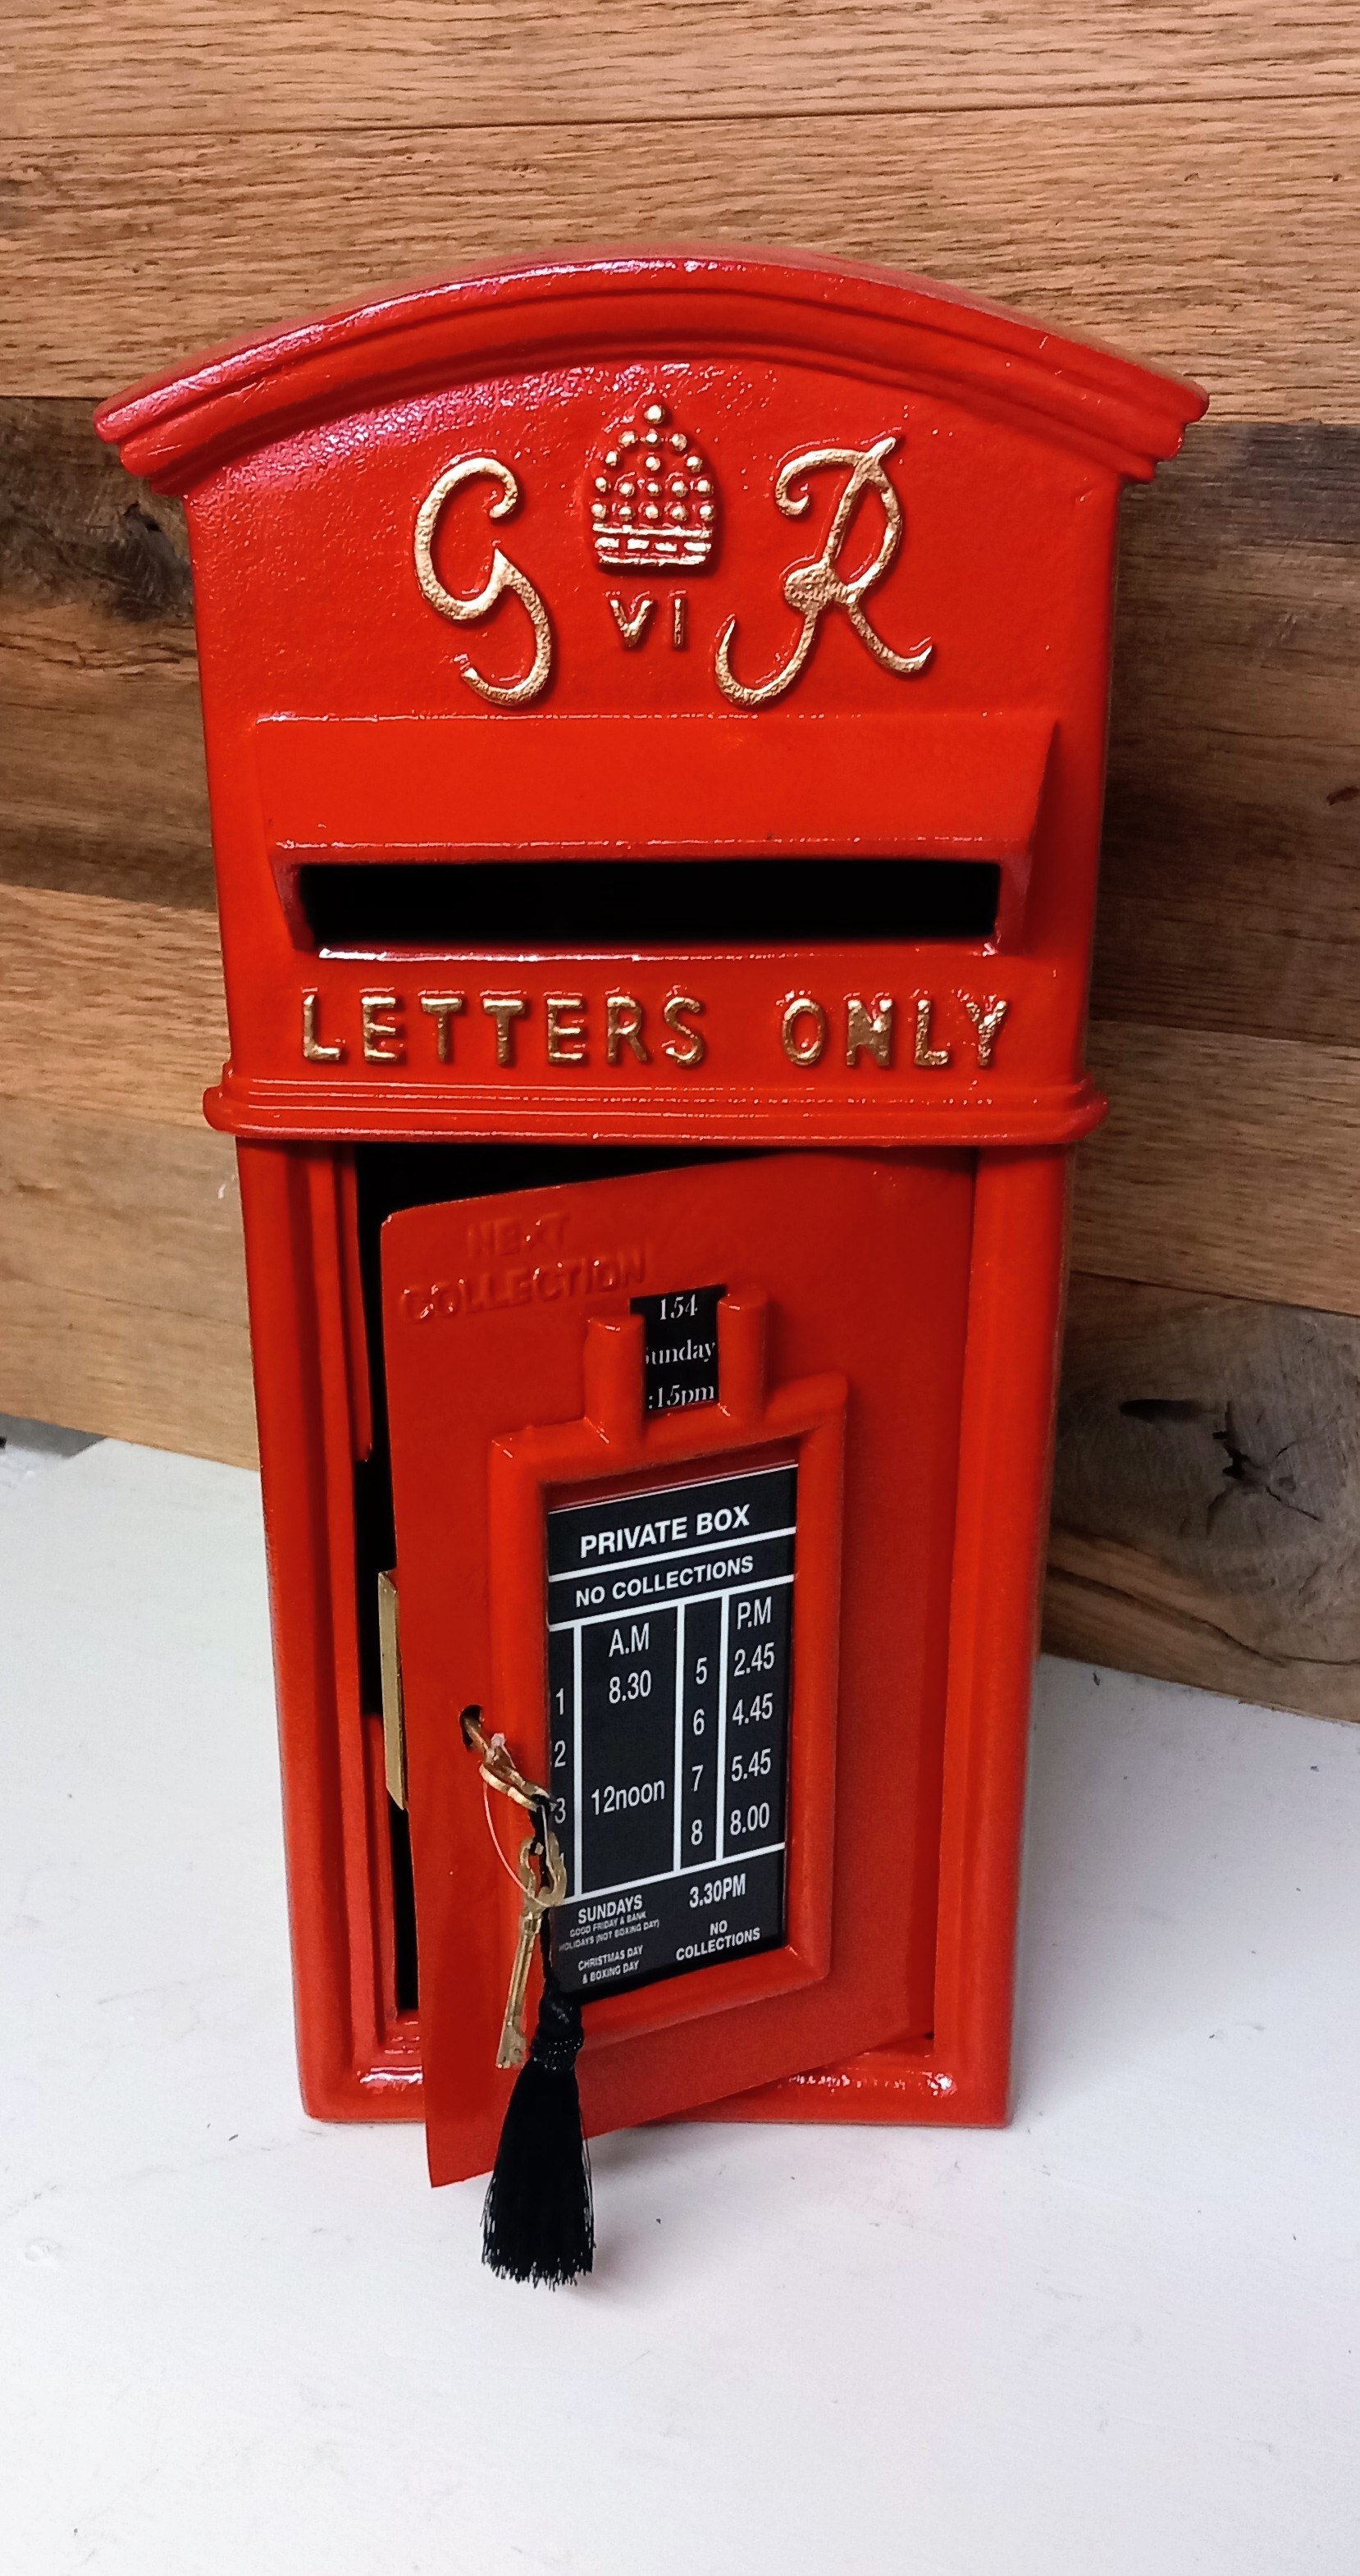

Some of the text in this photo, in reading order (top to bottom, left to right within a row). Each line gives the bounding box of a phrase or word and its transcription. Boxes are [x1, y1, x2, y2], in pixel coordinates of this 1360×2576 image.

[415, 457, 552, 706] G
[609, 597, 684, 648] VI
[302, 993, 1009, 1066] LETTERS ONLY
[467, 1212, 572, 1259] NEXT
[400, 1246, 646, 1322] COLLECTION
[659, 1294, 698, 1321] 154
[648, 1384, 714, 1409] :15pm
[581, 1504, 751, 1559] PRIVATE BOX
[576, 1555, 754, 1607] NO COLLECTIONS
[737, 1596, 773, 1630] P.M
[608, 1622, 650, 1658] A.M
[696, 1657, 708, 1685] 5
[733, 1642, 775, 1677] 2.45
[555, 1688, 564, 1715] 1
[609, 1669, 652, 1704] 8.30
[692, 1708, 705, 1736] 6
[732, 1692, 774, 1725] 4.45
[554, 1740, 567, 1768] 2
[731, 1748, 771, 1782] 5.45
[691, 1765, 704, 1792] 7
[554, 1797, 566, 1824] 3
[591, 1779, 666, 1816] 12noon
[691, 1820, 703, 1846] 8
[730, 1802, 770, 1836] 8.00
[689, 1873, 746, 1908] 3.30PM
[578, 1894, 642, 1925] SUNDAYS
[592, 1918, 618, 1932] FRIDAY
[675, 1927, 760, 1961] COLLECTIONS
[710, 1920, 728, 1936] NO
[577, 1944, 644, 1971] CHRISTMAS DAY
[590, 1965, 621, 1982] BOXING
[623, 1960, 640, 1973] DAY
